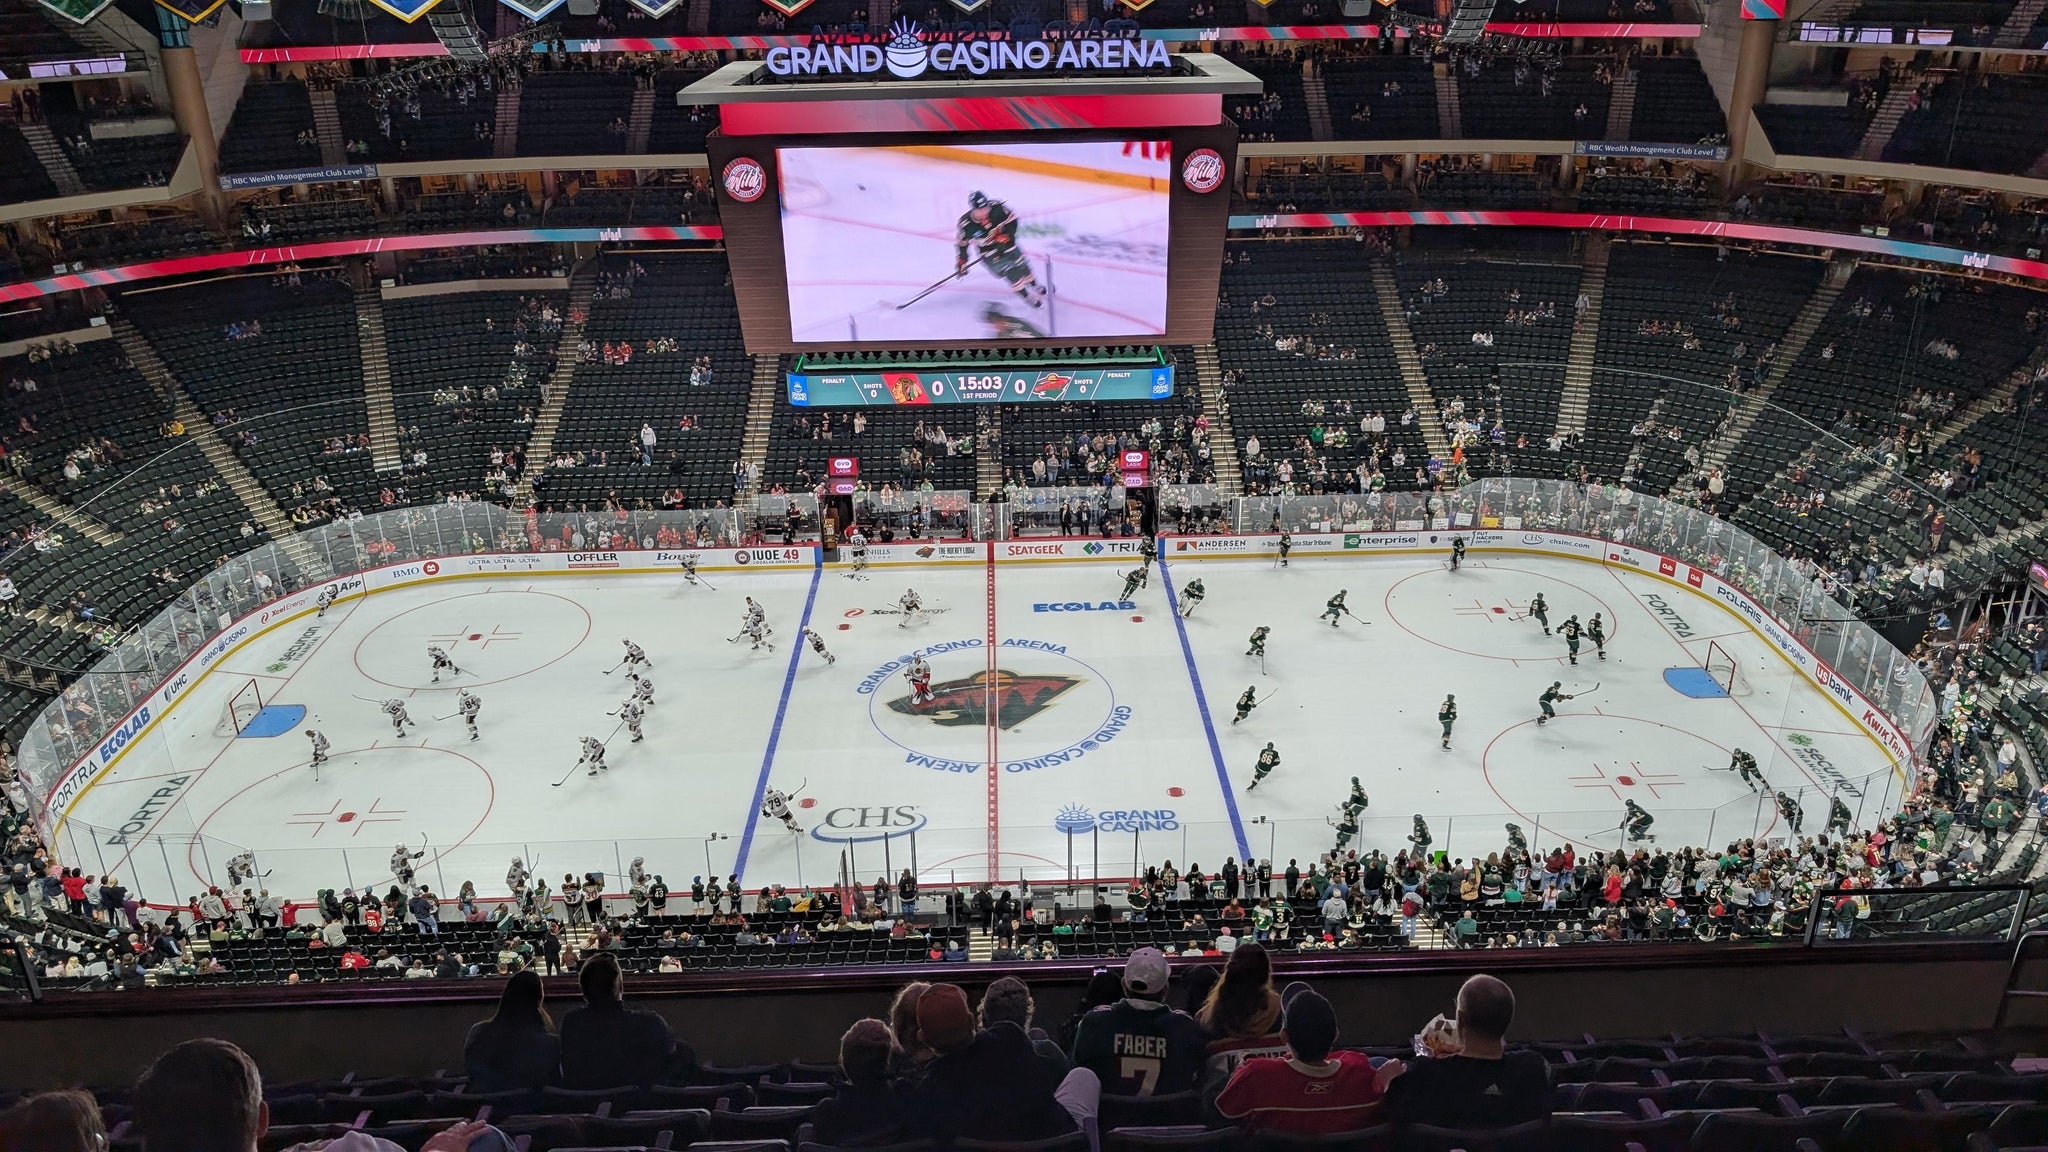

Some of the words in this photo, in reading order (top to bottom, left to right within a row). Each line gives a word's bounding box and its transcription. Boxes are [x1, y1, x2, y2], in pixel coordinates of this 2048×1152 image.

[766, 44, 884, 75] GRAND
[930, 41, 1051, 75] CASINO
[1055, 39, 1172, 69] ARENA
[1604, 144, 1628, 152] Wealth
[1630, 146, 1675, 154] Management
[1676, 147, 1692, 155] Club
[1183, 157, 1221, 182] Wild
[232, 177, 248, 185] RBC
[249, 174, 276, 184] Wealth
[276, 171, 325, 181] Management
[325, 168, 342, 177] Club
[343, 167, 363, 176] Level
[725, 166, 762, 192] Wild
[931, 380, 944, 396] 0
[958, 376, 1002, 390] 15:03
[1014, 379, 1026, 394] 0
[870, 389, 878, 398] 0
[1080, 386, 1086, 394] 0
[1346, 536, 1416, 546] enterprise
[1524, 533, 1542, 541] CHS
[962, 546, 975, 554] LODGE
[1008, 544, 1064, 556] SEATGEEK
[1198, 540, 1246, 548] ANDERSEN
[1549, 539, 1590, 549] chsinc.com
[567, 552, 618, 562] LOFFLER
[752, 550, 780, 560] IUOE
[783, 549, 799, 560] 49
[1620, 556, 1640, 566] YouTube
[1662, 563, 1673, 571] Cub
[392, 567, 420, 578] BMO
[1690, 574, 1700, 582] Cub
[340, 581, 362, 593] APP
[272, 606, 286, 618] Xcel
[286, 599, 306, 611] Energy
[1033, 601, 1136, 613] ECOLAB
[1717, 586, 1762, 624] POLARIS
[1641, 593, 1696, 638] FORTRA
[201, 646, 219, 666] GRAND
[224, 626, 248, 646] CASINO
[279, 626, 321, 662] securian
[1764, 624, 1782, 645] GRAND
[1787, 644, 1806, 665] CASINO
[856, 661, 900, 694] GRAND
[912, 638, 983, 657] CASINO
[1002, 638, 1069, 654] ARENA
[170, 674, 188, 694] UHC
[1816, 666, 1829, 682] us
[1829, 674, 1853, 706] bank
[465, 698, 476, 709] 84
[1095, 705, 1132, 743] GRAND
[100, 706, 151, 764] ECOLAB
[905, 752, 981, 773] ARENA
[1006, 748, 1084, 773] CASINO
[1261, 753, 1273, 765] 86
[1803, 748, 1862, 798] securian
[52, 760, 98, 816] FORTRA
[768, 797, 781, 810] 79
[105, 775, 191, 845] FORTRA
[1098, 810, 1176, 821] GRAND
[825, 806, 916, 829] CHS
[1098, 821, 1179, 833] CASINO
[585, 891, 598, 900] 30
[654, 890, 664, 898] 43
[1213, 890, 1225, 899] 46
[244, 905, 254, 914] 97
[1258, 916, 1264, 924] 7
[1277, 912, 1284, 922] 3
[1114, 1034, 1167, 1058] FABER
[1120, 1058, 1161, 1096] 7
